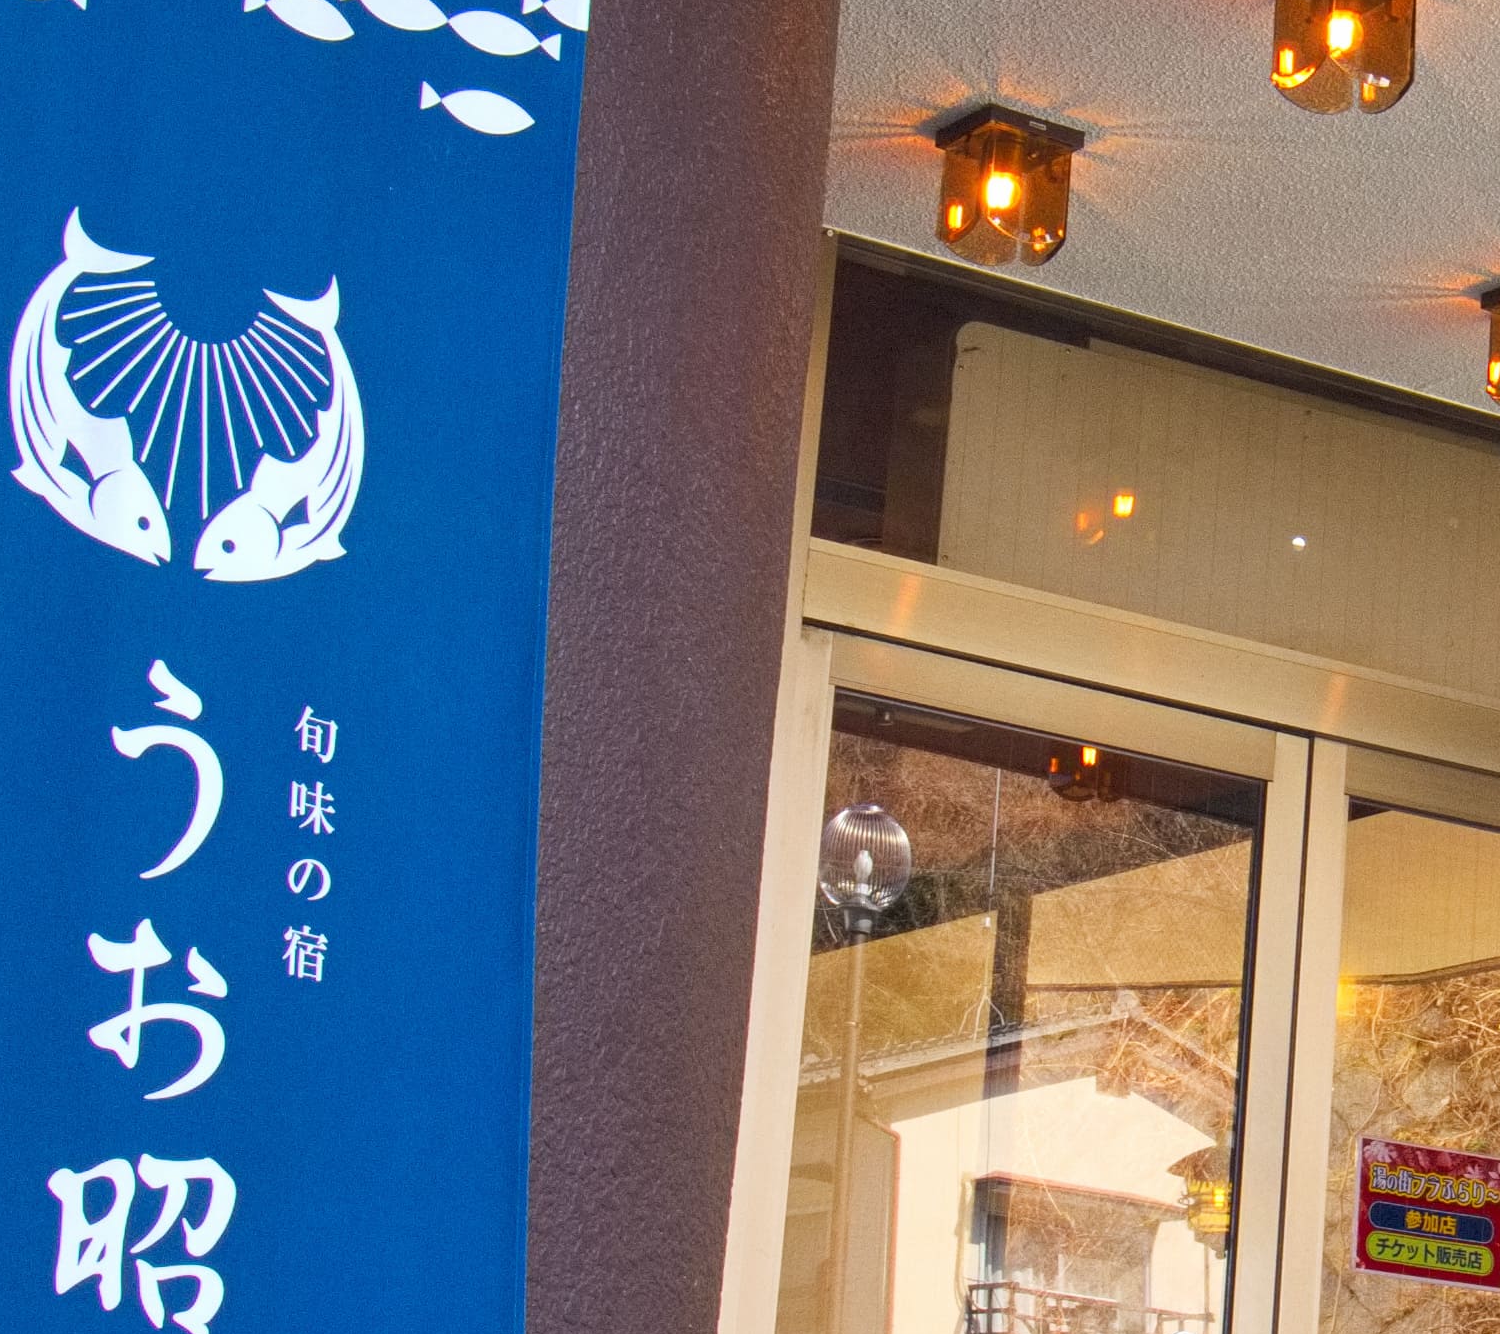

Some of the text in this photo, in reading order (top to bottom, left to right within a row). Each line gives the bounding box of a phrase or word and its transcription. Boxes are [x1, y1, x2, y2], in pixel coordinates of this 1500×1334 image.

[282, 705, 339, 983] 旬味の宿
[1404, 1209, 1457, 1236] 参加店
[1375, 1237, 1483, 1270] チケット販売店
